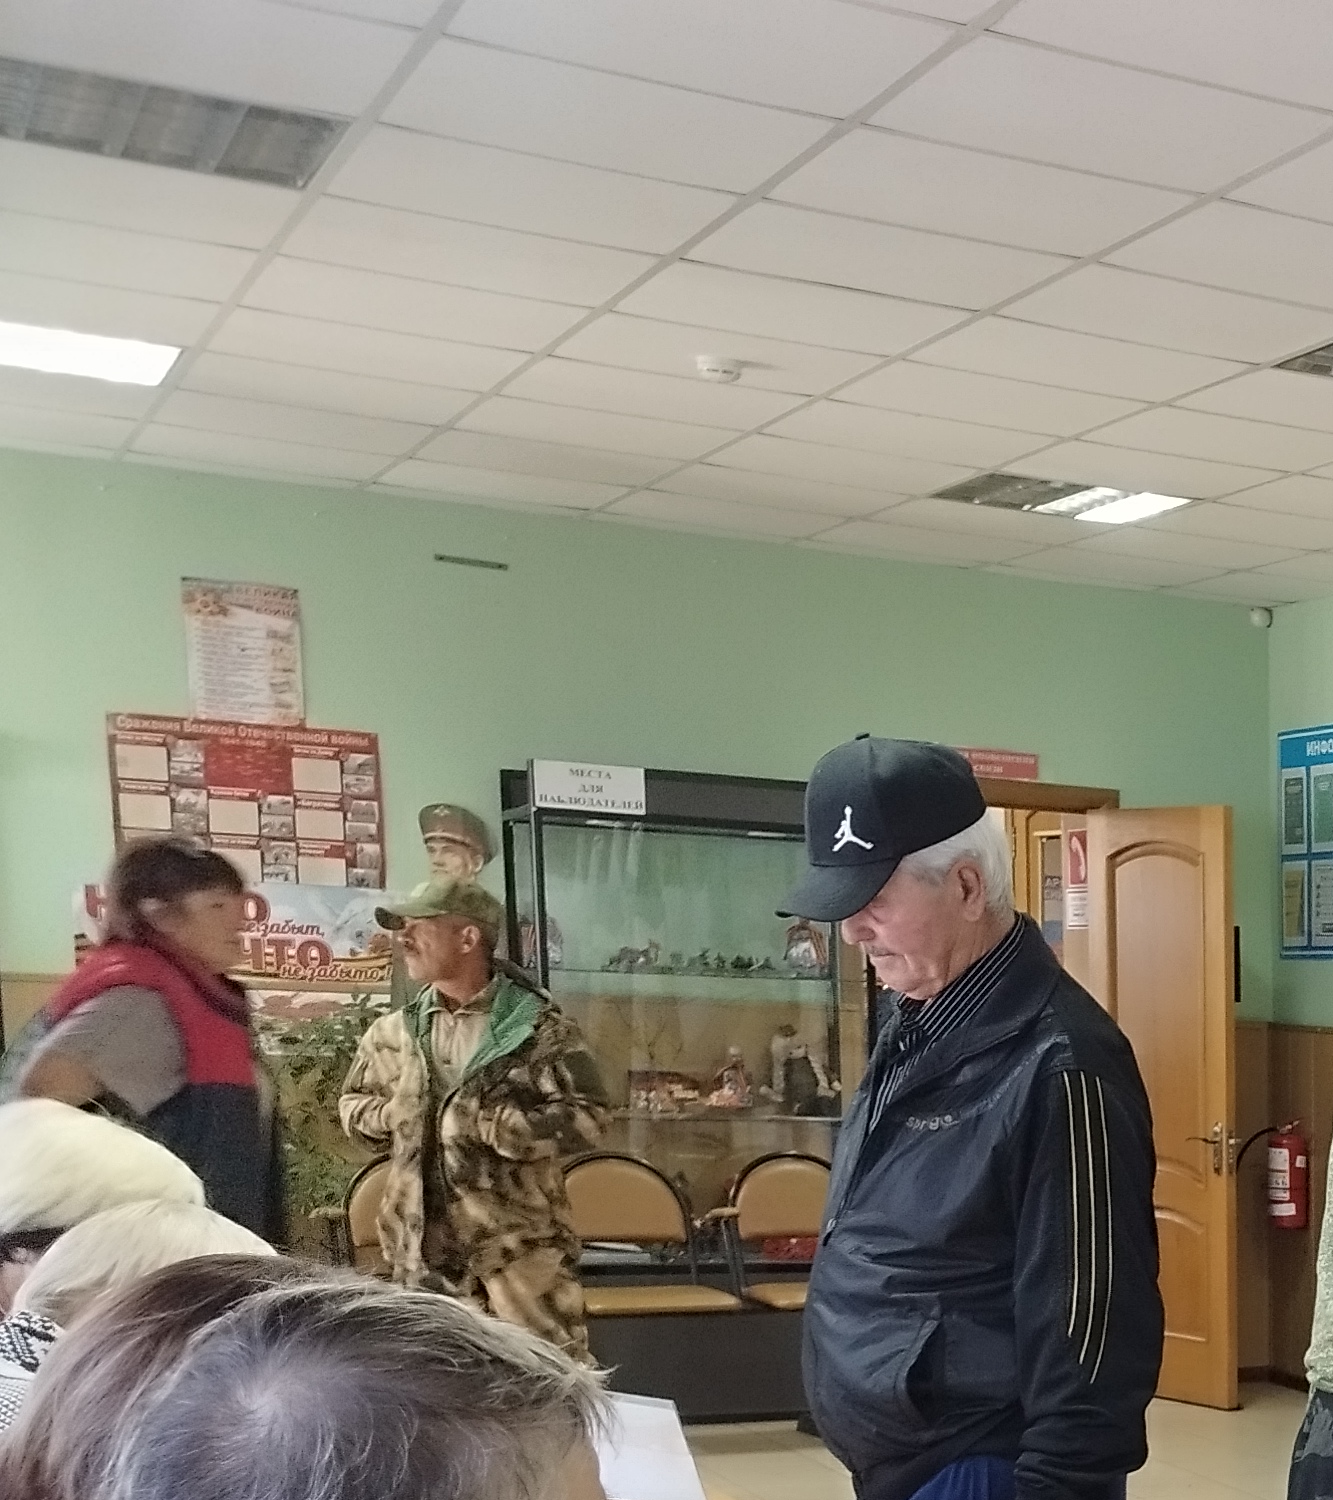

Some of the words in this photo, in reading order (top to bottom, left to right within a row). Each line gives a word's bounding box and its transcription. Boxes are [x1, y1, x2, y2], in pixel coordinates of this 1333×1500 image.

[116, 714, 181, 733] Сражения
[183, 719, 236, 736] Великой
[569, 768, 612, 780] МЕСТА
[578, 784, 604, 793] ДЛЯ
